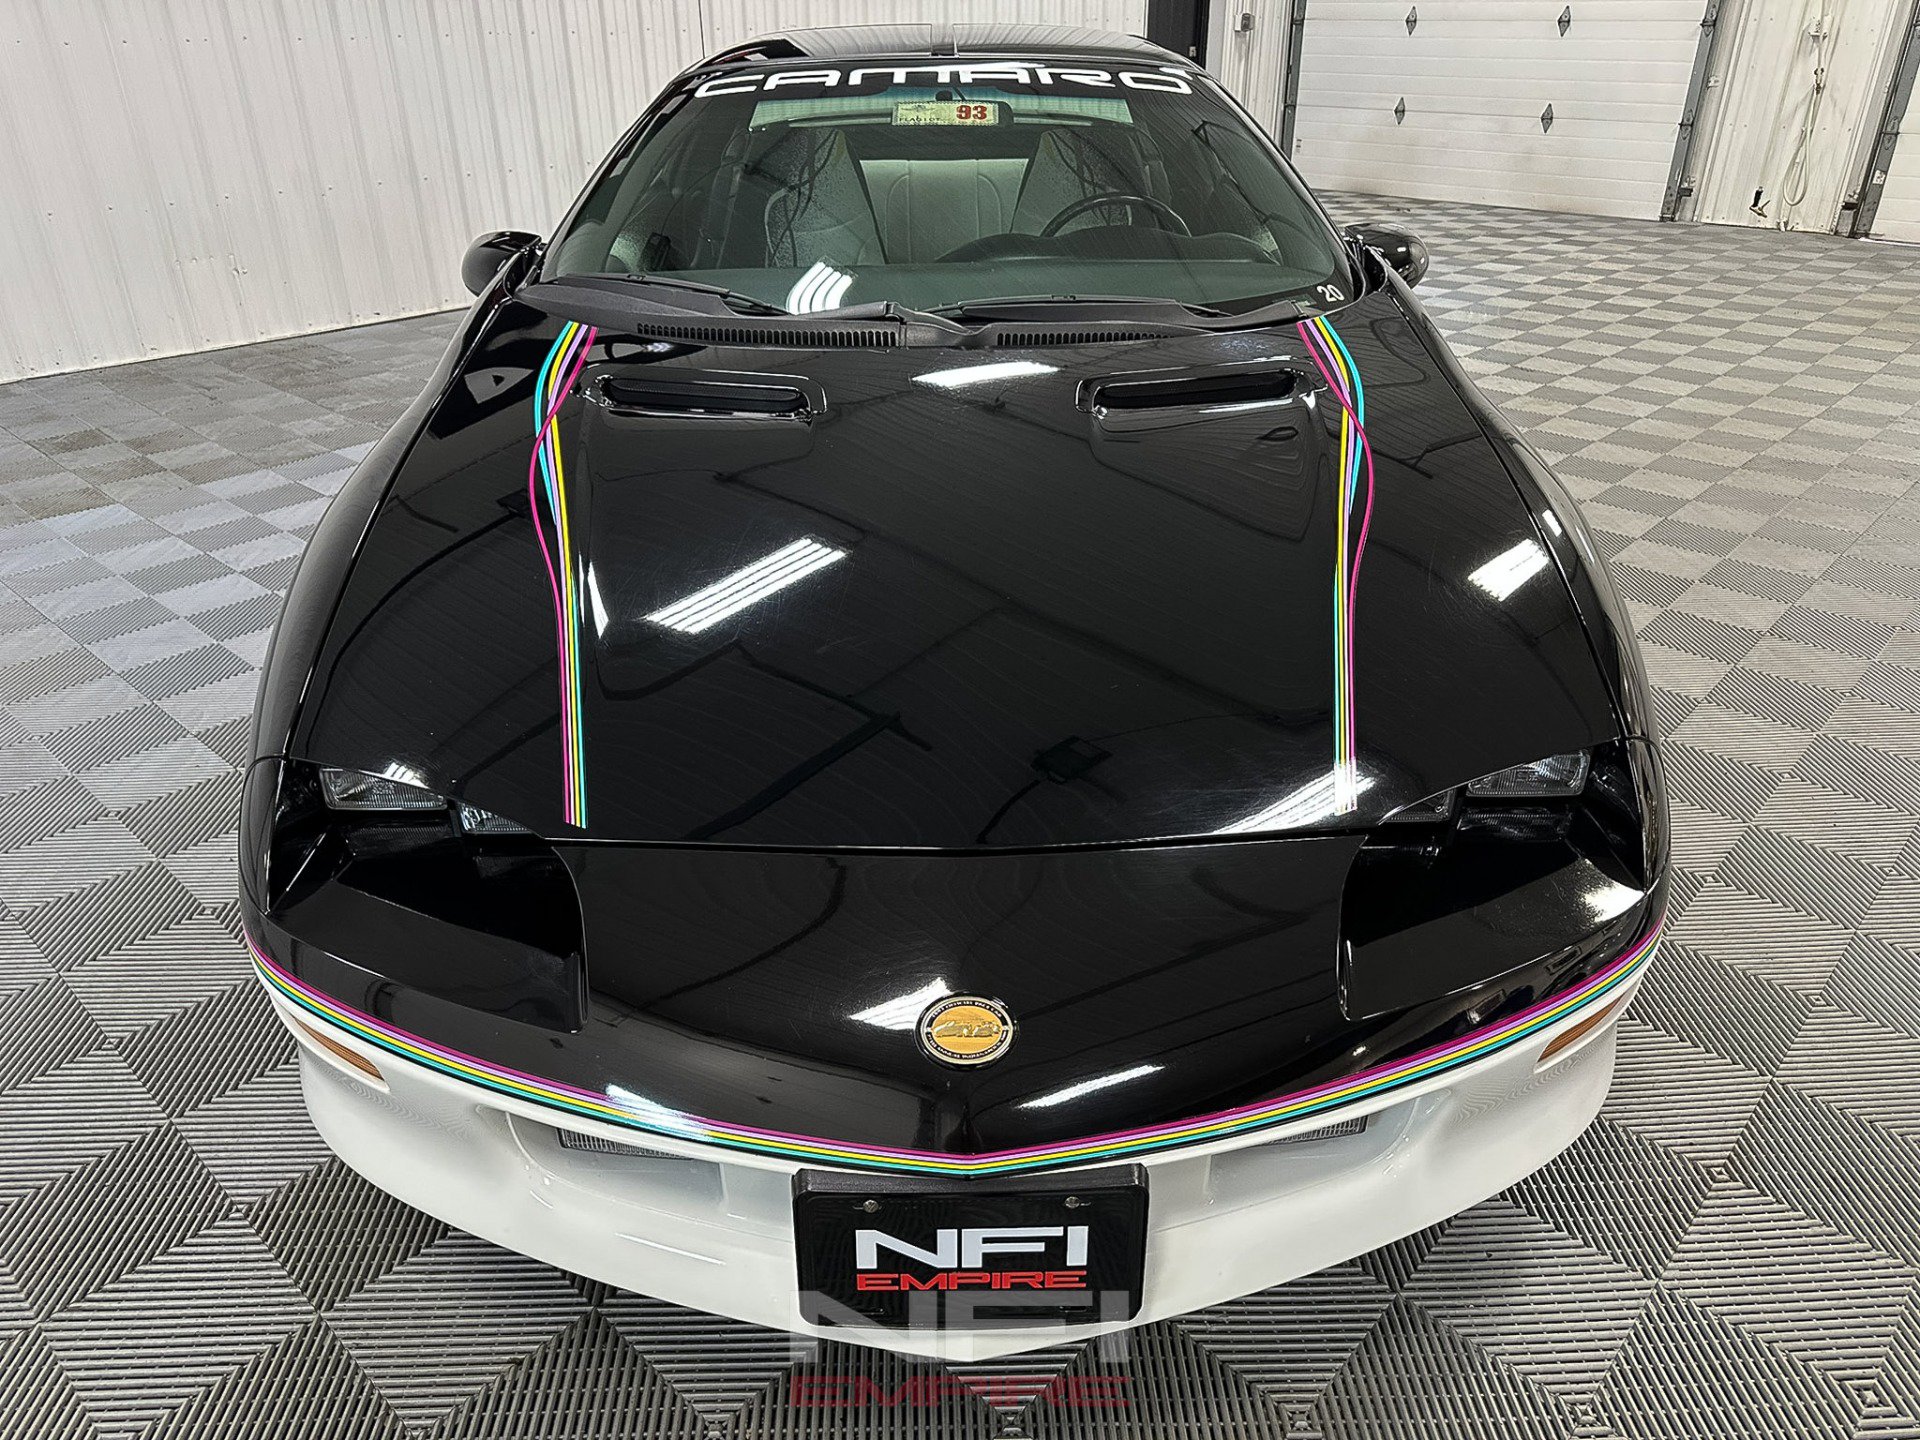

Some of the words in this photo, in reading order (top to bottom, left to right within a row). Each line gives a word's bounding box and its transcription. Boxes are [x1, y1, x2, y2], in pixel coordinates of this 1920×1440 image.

[694, 65, 1193, 98] CAMARO
[956, 104, 987, 120] 93
[1316, 284, 1345, 302] 20
[855, 1225, 1089, 1269] NFI
[856, 1271, 1087, 1290] EMPIRE
